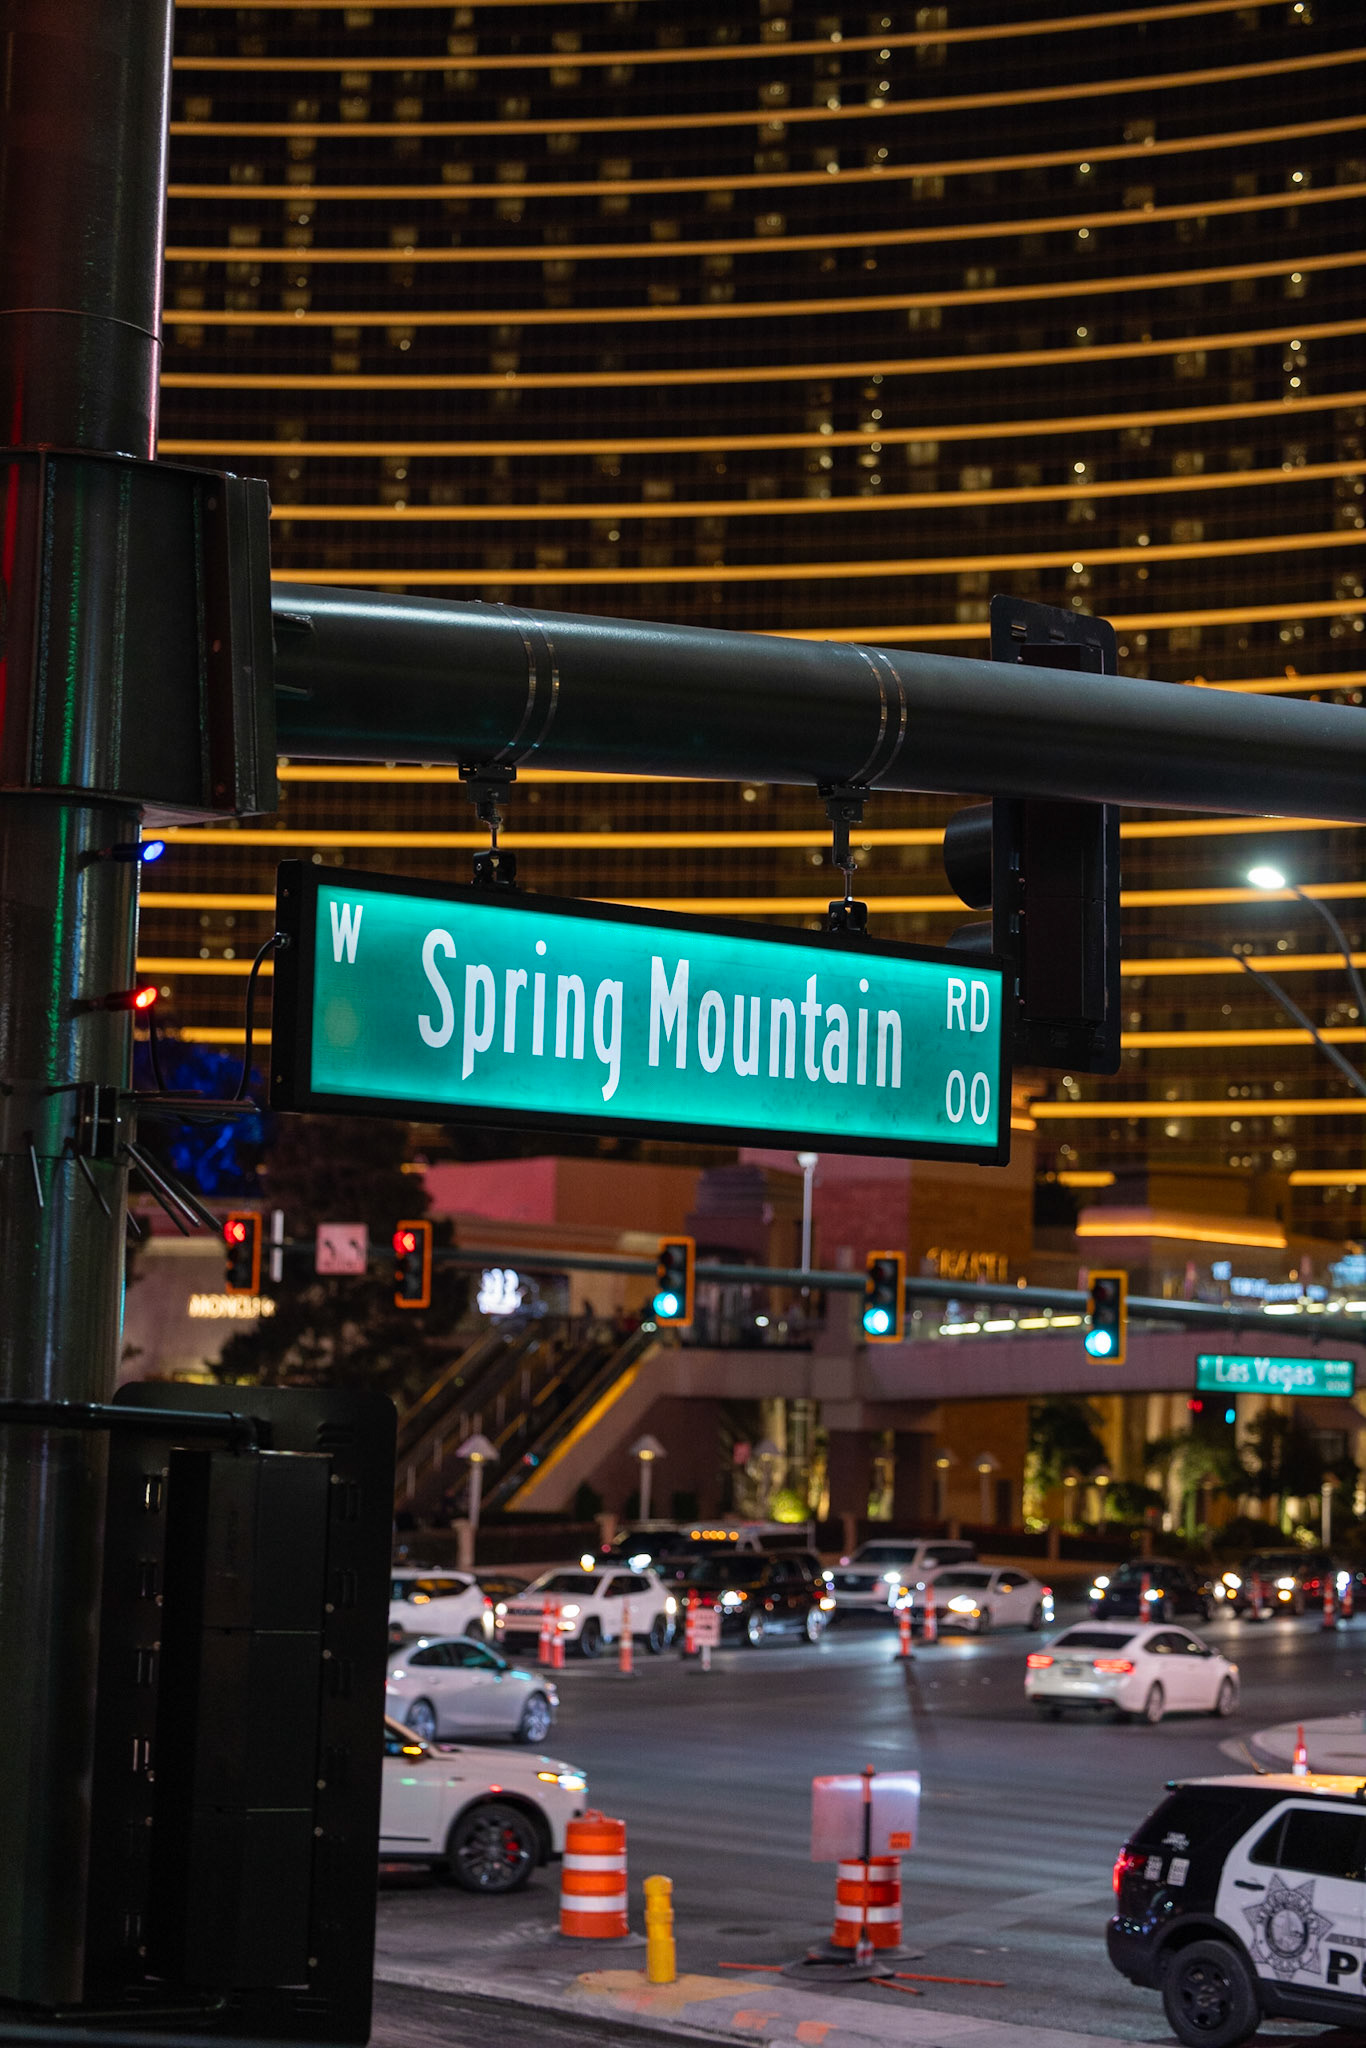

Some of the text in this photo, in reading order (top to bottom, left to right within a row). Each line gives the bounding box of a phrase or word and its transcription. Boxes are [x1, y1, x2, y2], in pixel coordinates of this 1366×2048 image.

[329, 901, 991, 1103] W Spring Mountain RD
[1215, 1356, 1249, 1382] Las
[1254, 1357, 1315, 1392] Vegas
